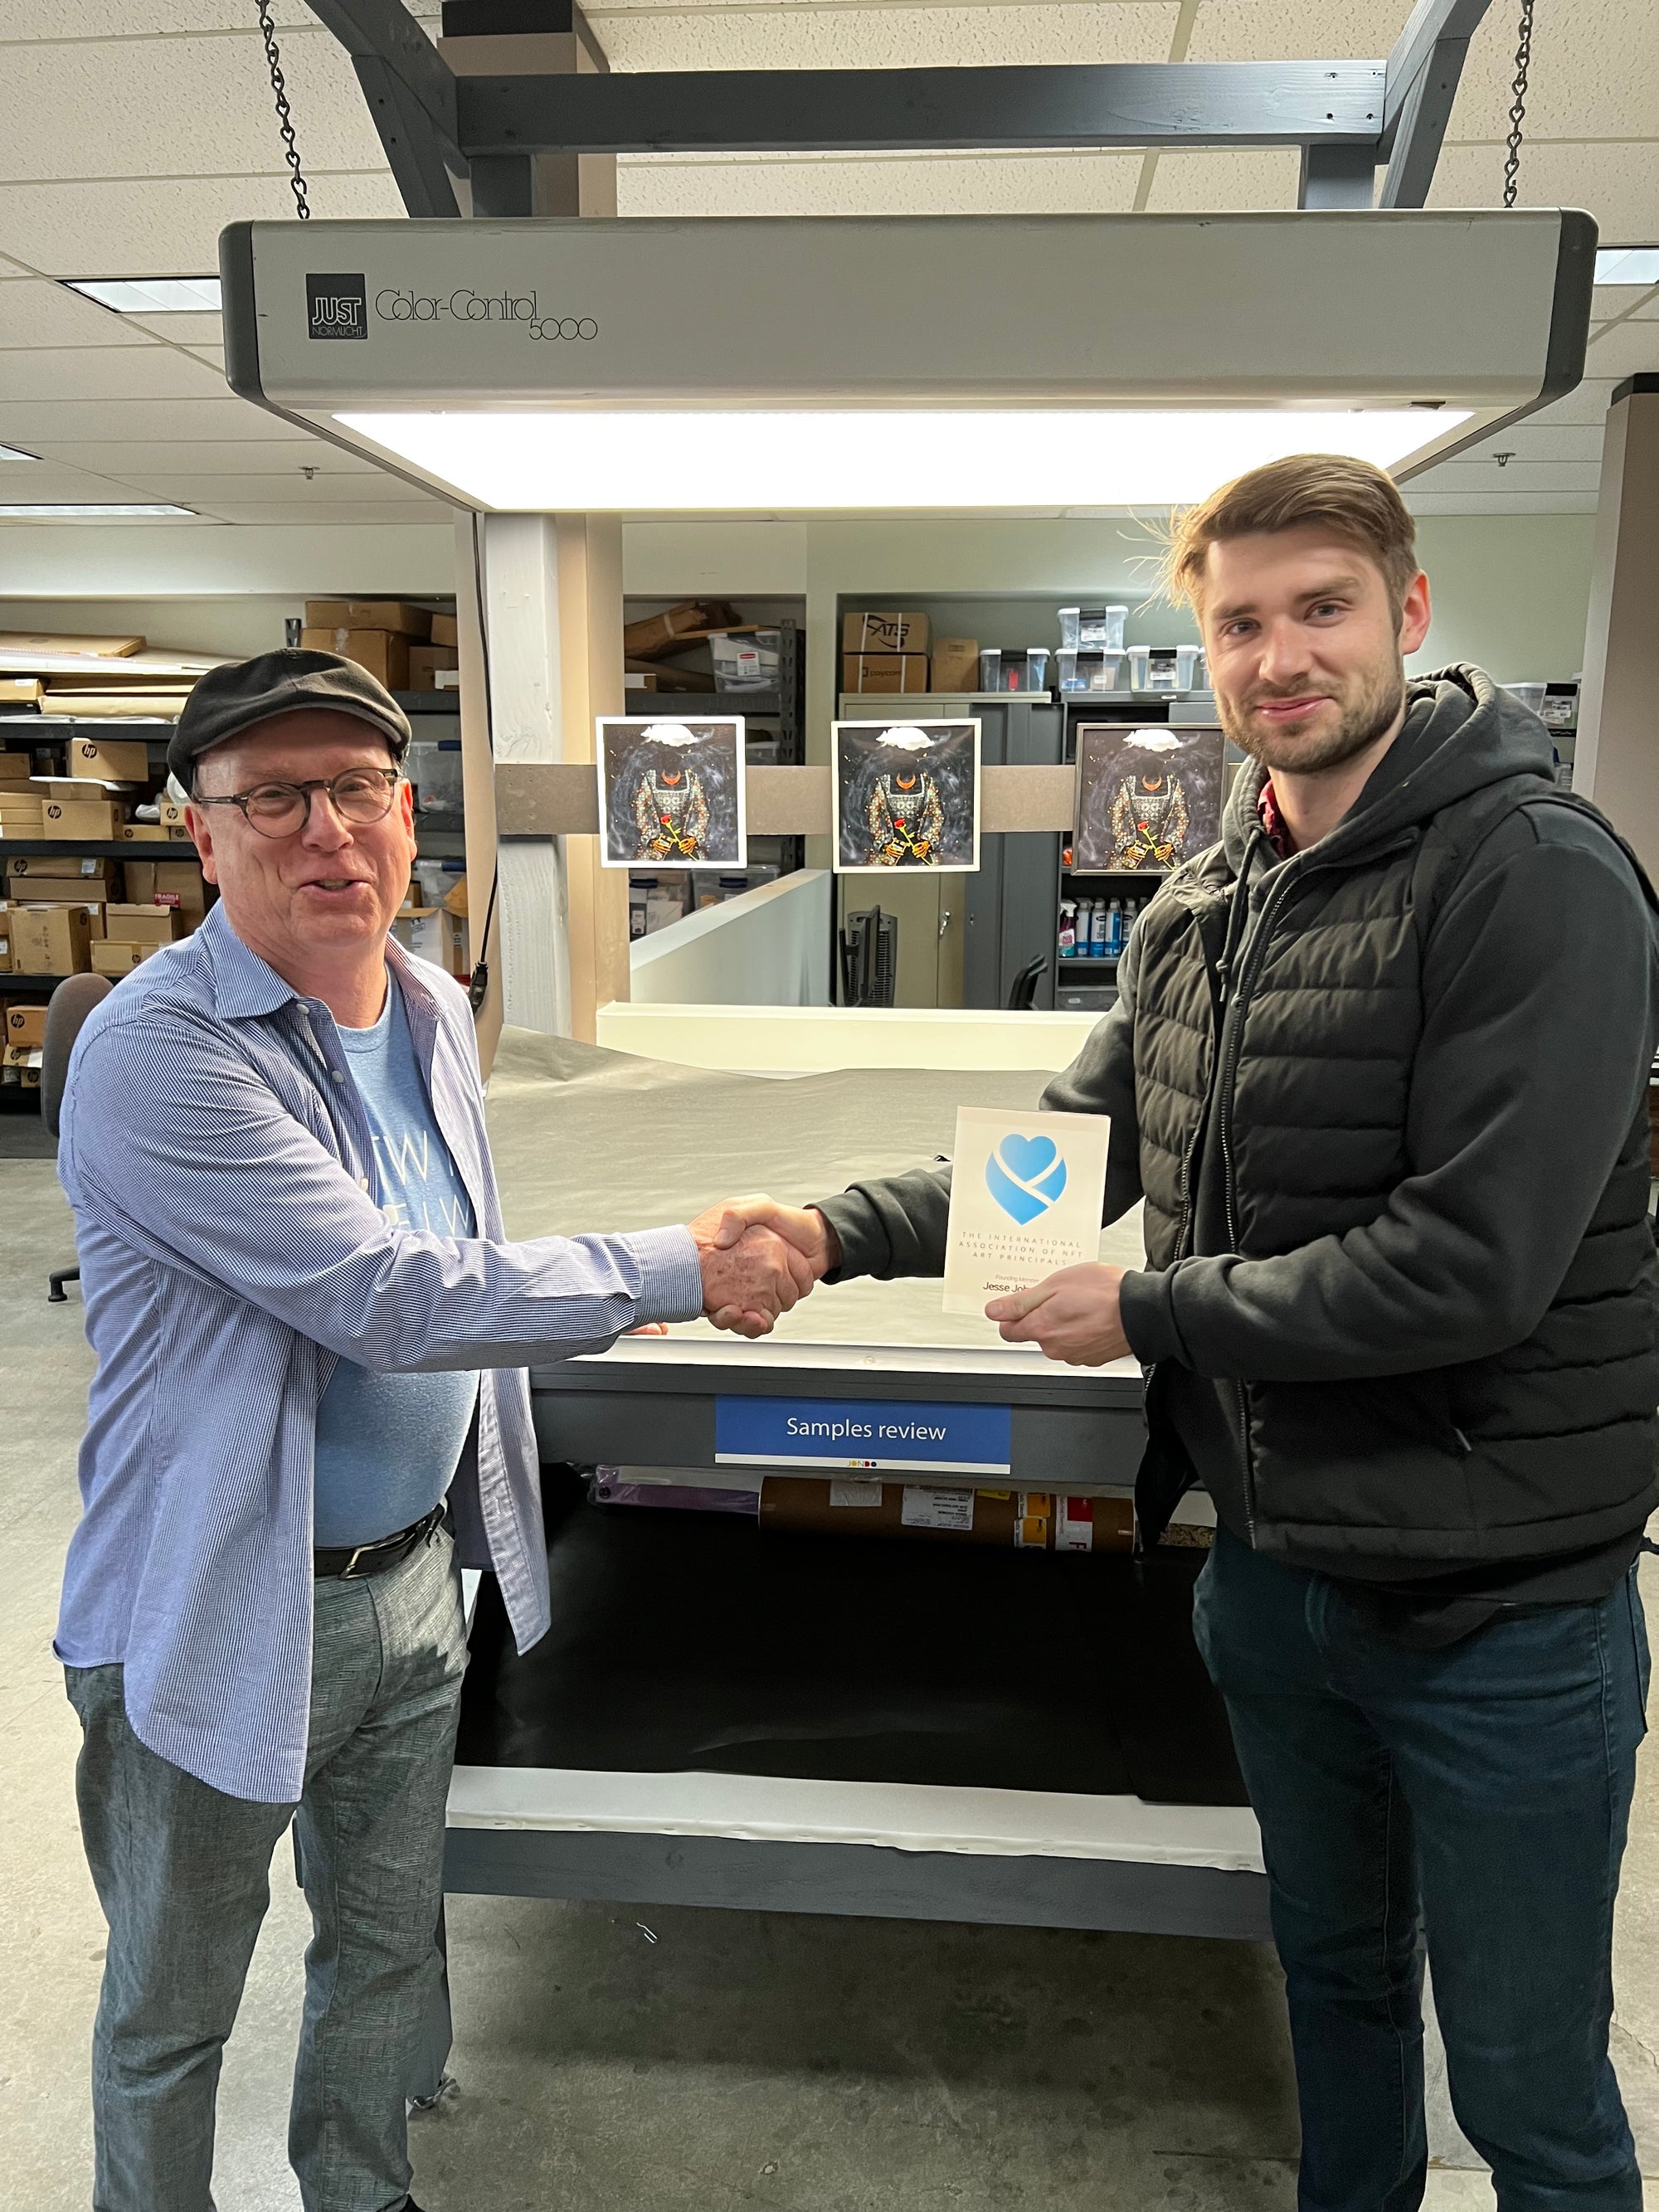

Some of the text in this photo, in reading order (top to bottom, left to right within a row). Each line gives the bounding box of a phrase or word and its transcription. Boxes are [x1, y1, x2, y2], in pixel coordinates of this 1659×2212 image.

[312, 297, 362, 325] JUST
[375, 289, 540, 321] Color-Control
[528, 318, 598, 340] 5000
[82, 744, 97, 758] hp
[48, 805, 61, 819] hp
[167, 807, 178, 819] hp
[14, 859, 27, 873] hp
[11, 1014, 24, 1028] hp
[959, 1242, 1035, 1253] ASSOCIATION
[989, 1234, 1081, 1248] INTERNATIONAL
[1000, 1254, 1067, 1266] PRINCIPALS
[983, 1281, 1010, 1292] Jesse
[786, 1417, 946, 1441] Samples review
